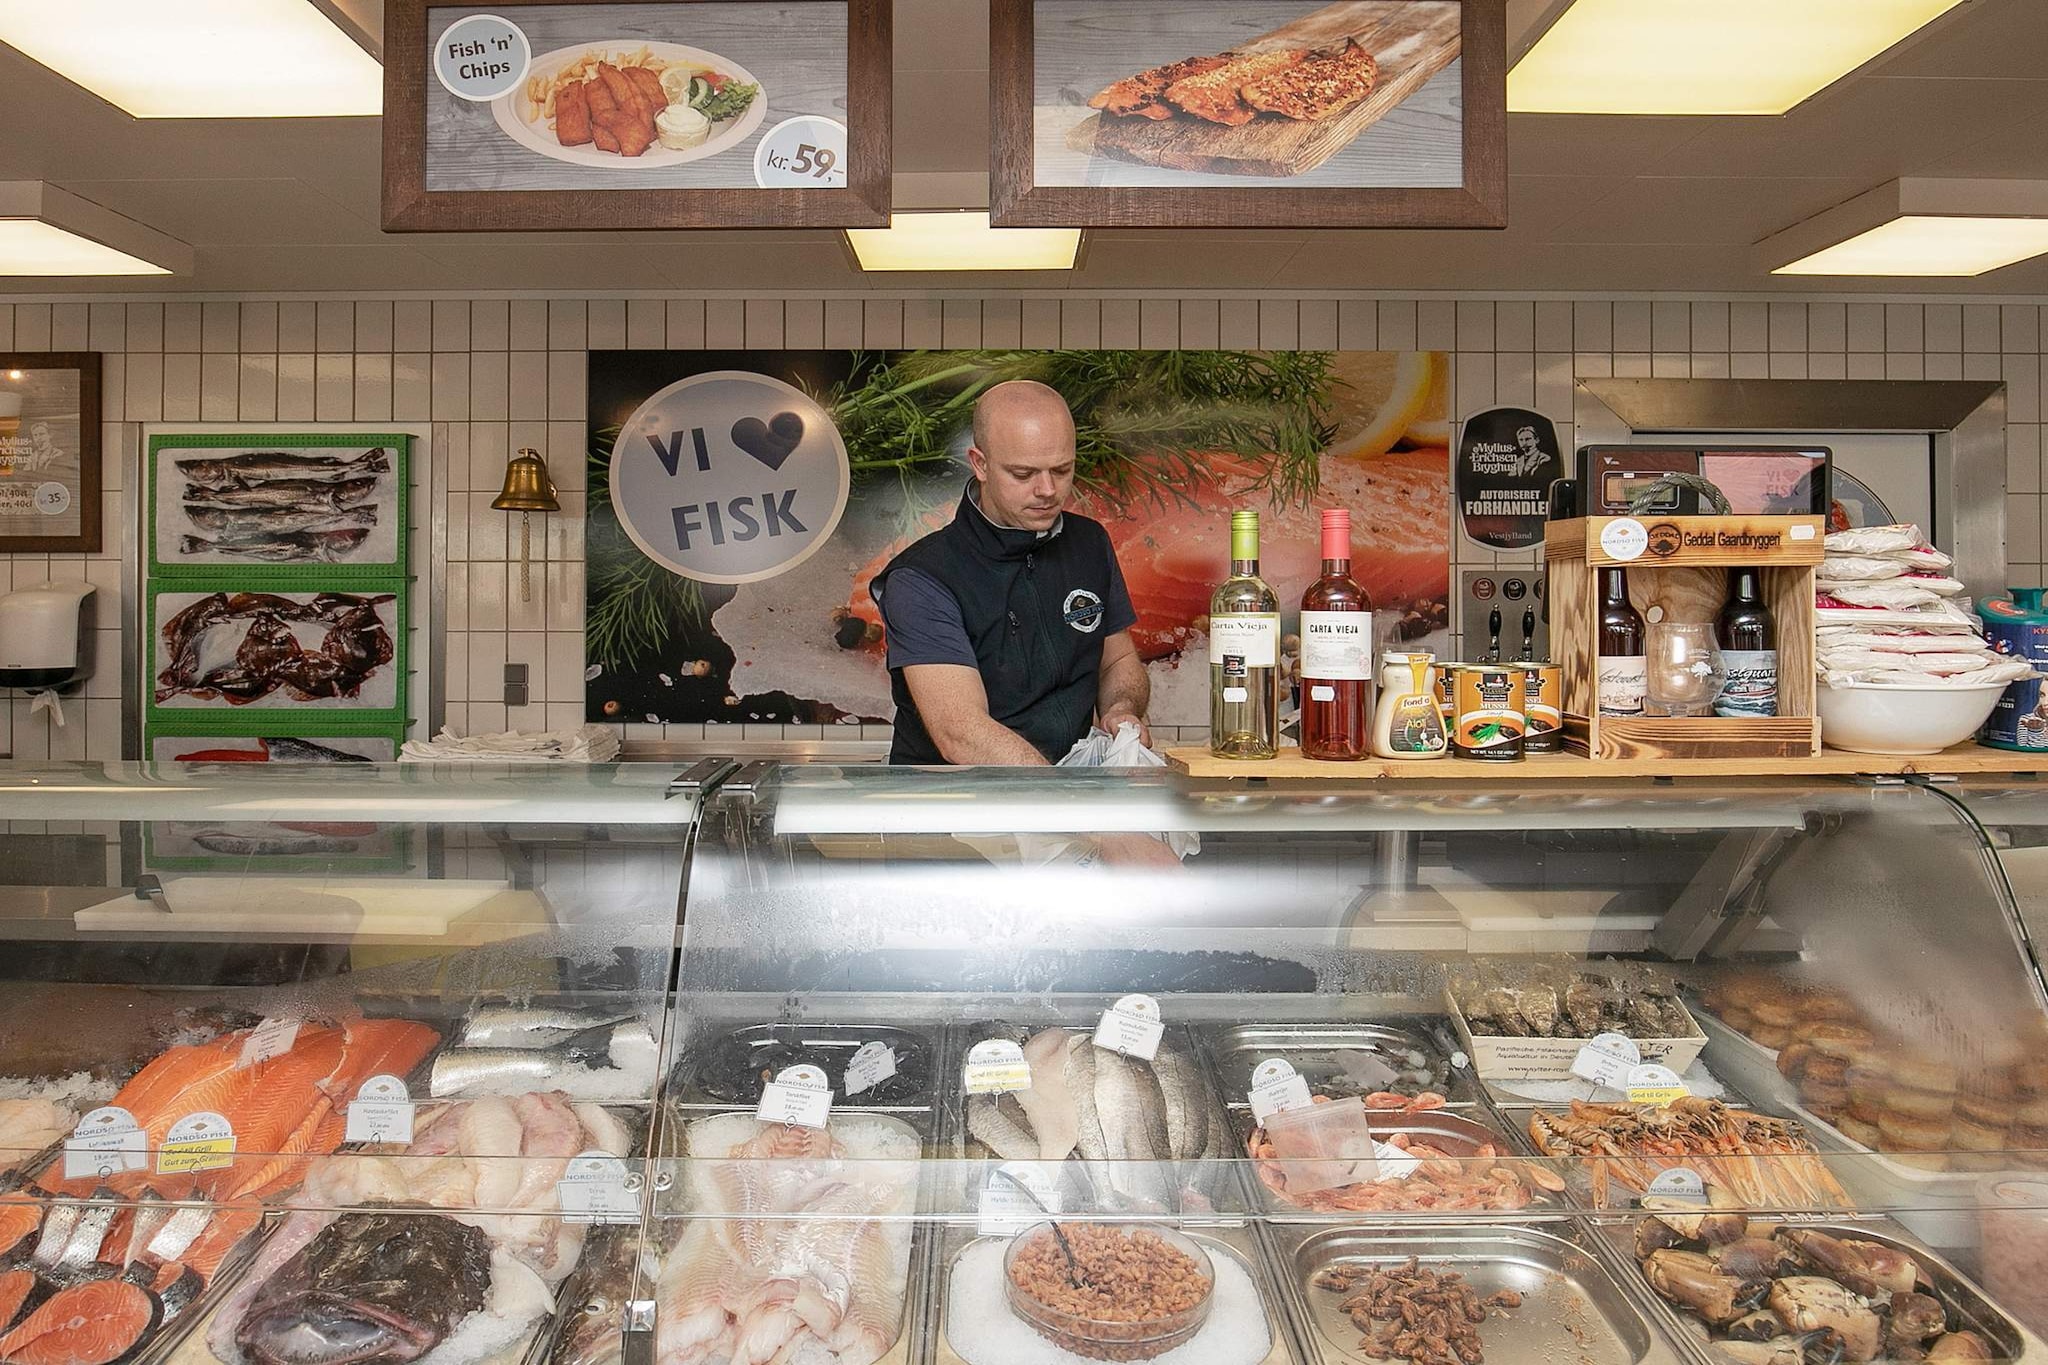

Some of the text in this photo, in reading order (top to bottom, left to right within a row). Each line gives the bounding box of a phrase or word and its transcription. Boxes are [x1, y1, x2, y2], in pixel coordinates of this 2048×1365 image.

[448, 40, 486, 60] Fish
[459, 61, 511, 79] Chips
[767, 149, 789, 170] kr.
[646, 427, 712, 477] VI
[1479, 489, 1541, 500] AUTORISERET
[671, 488, 808, 551] FISK
[1684, 531, 1716, 547] Geddal
[1237, 621, 1268, 631] Vieja
[1309, 624, 1359, 634] CARTA VIEJA
